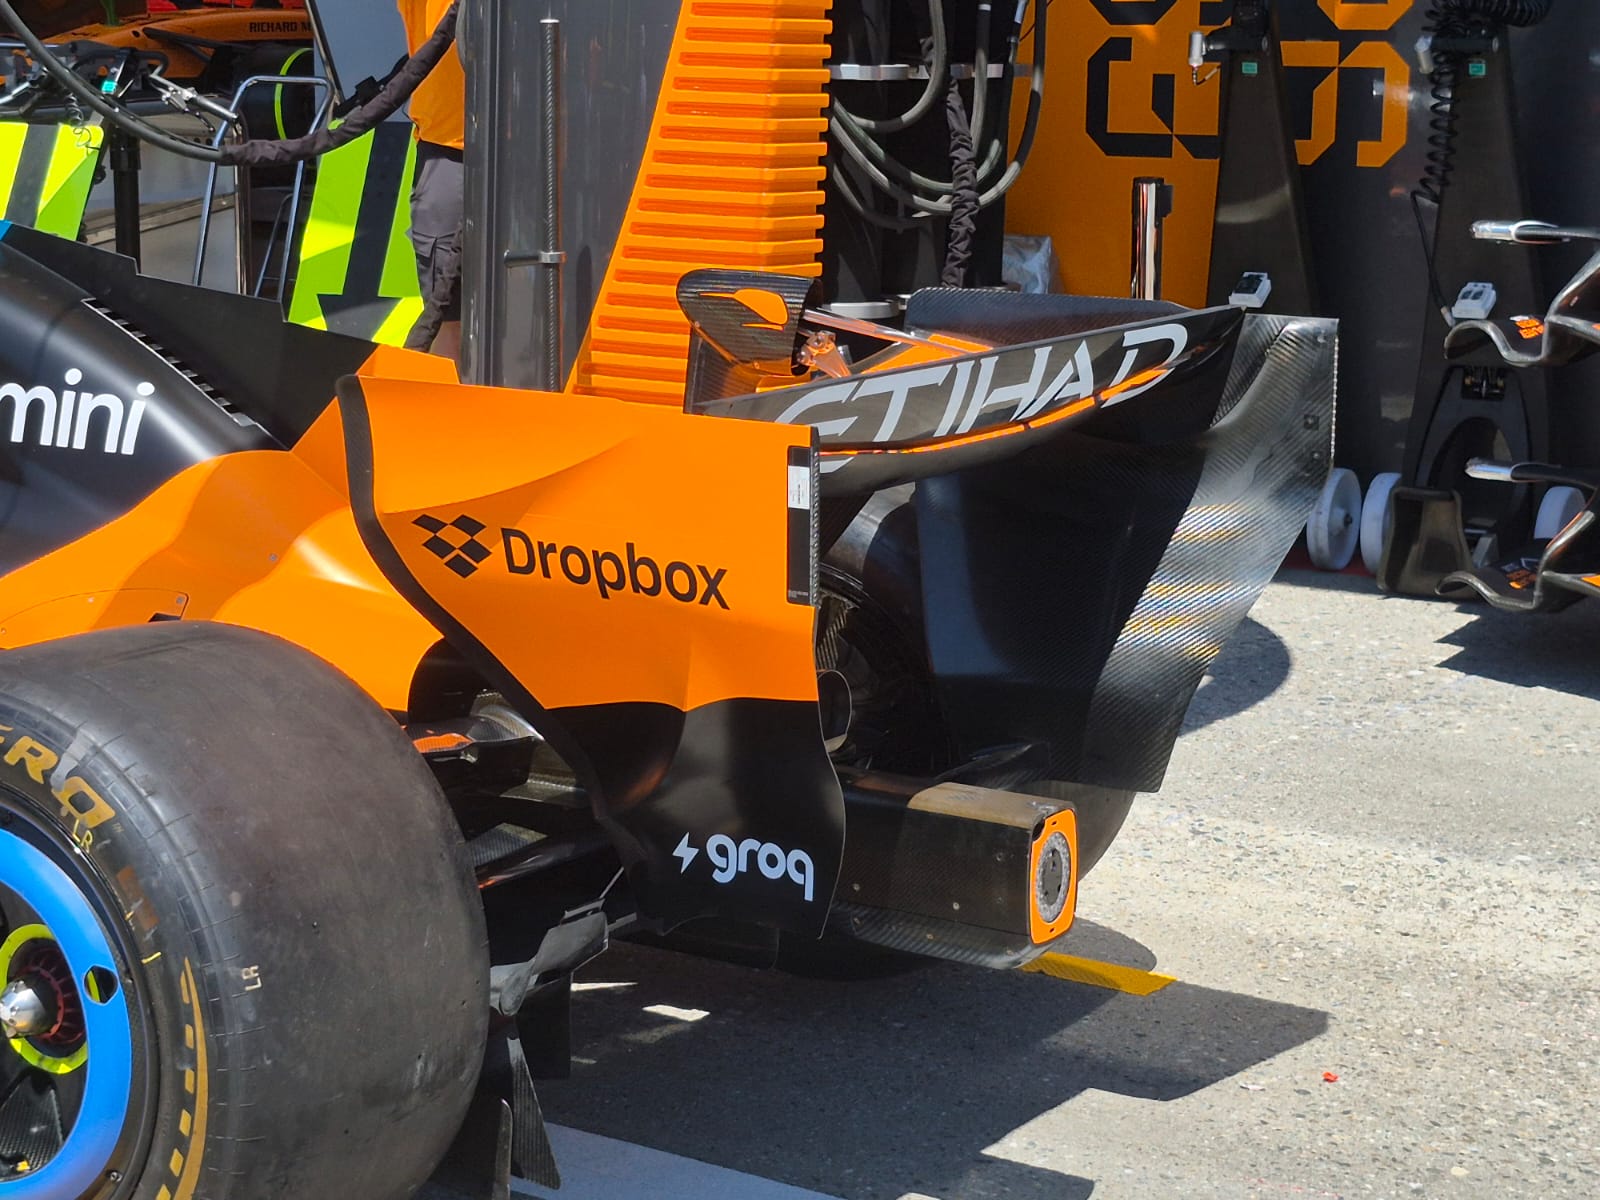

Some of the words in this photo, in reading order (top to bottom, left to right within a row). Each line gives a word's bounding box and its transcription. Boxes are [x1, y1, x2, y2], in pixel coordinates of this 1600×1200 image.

[249, 21, 298, 33] RICHARD
[774, 322, 1189, 474] ETIHAD
[500, 527, 730, 610] Dropbox
[706, 833, 814, 901] groq
[241, 965, 262, 991] LR
